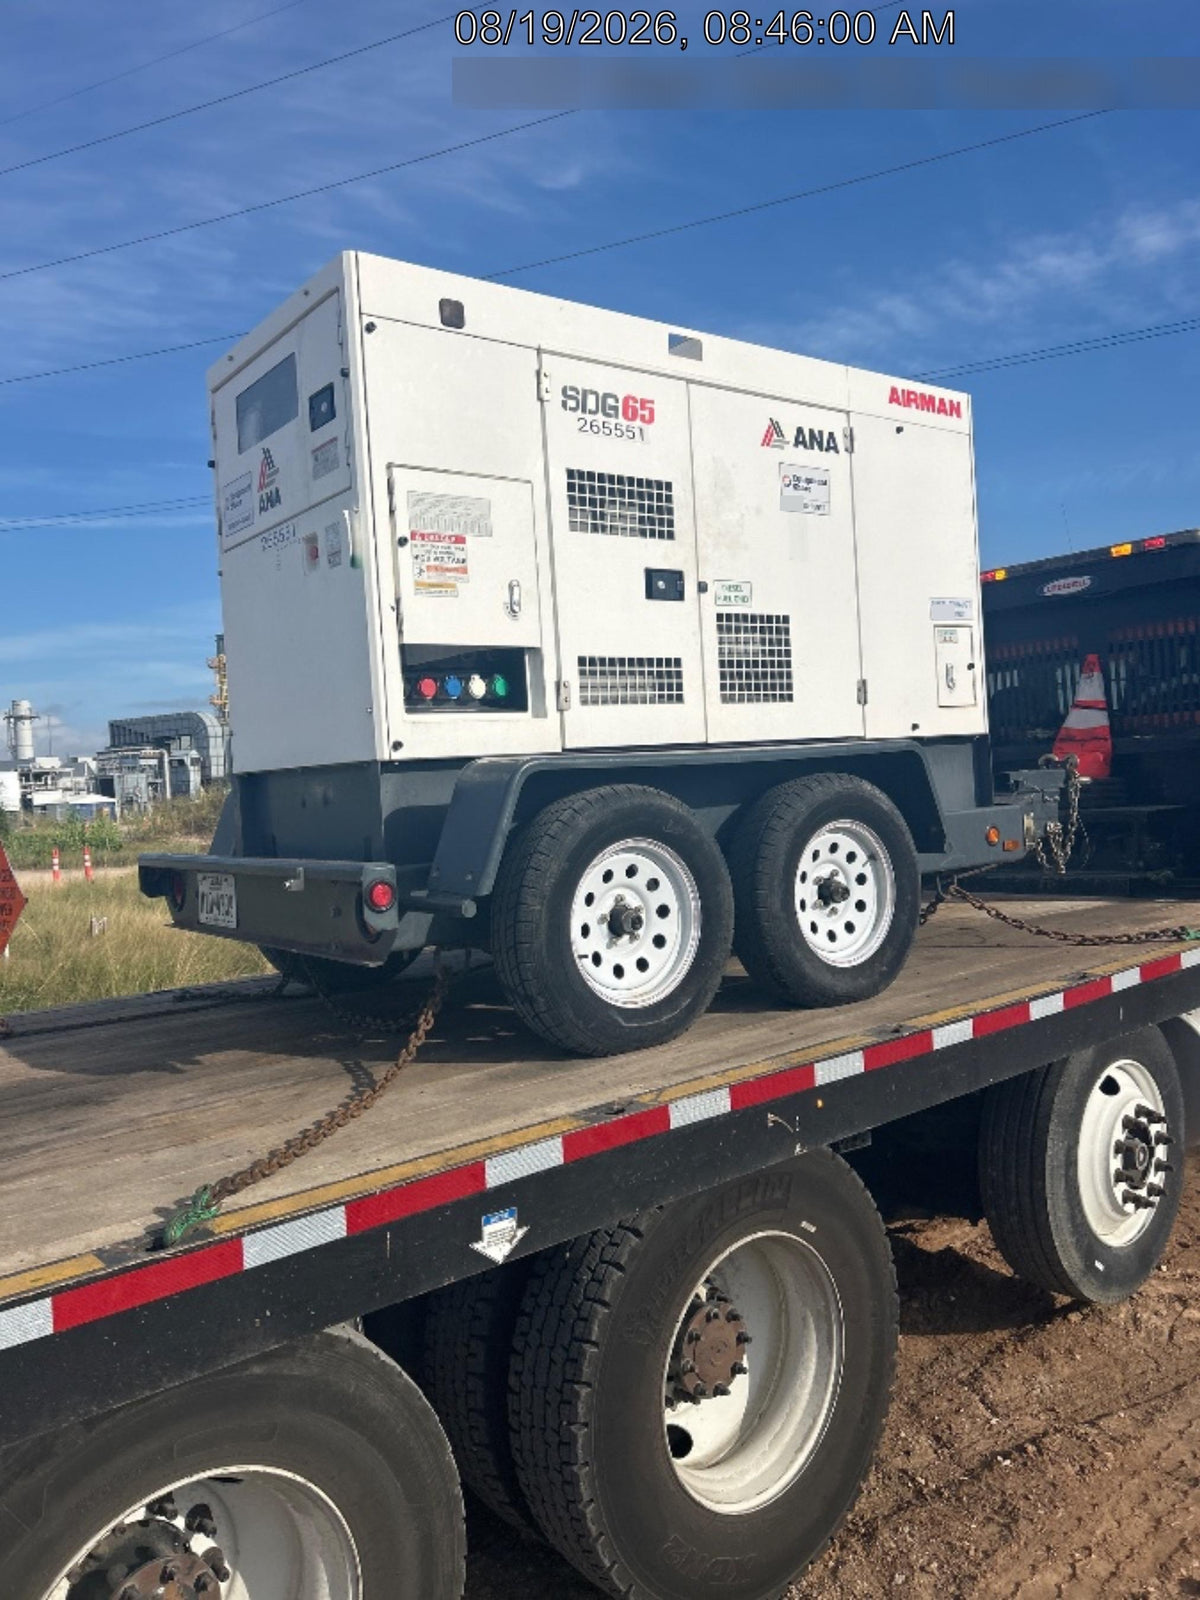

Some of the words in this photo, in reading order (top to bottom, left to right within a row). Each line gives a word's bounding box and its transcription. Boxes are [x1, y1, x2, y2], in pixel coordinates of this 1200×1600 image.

[561, 384, 655, 425] SDG65
[888, 385, 962, 419] AIRMAN
[577, 417, 645, 442] 265551
[793, 426, 840, 454] ANA
